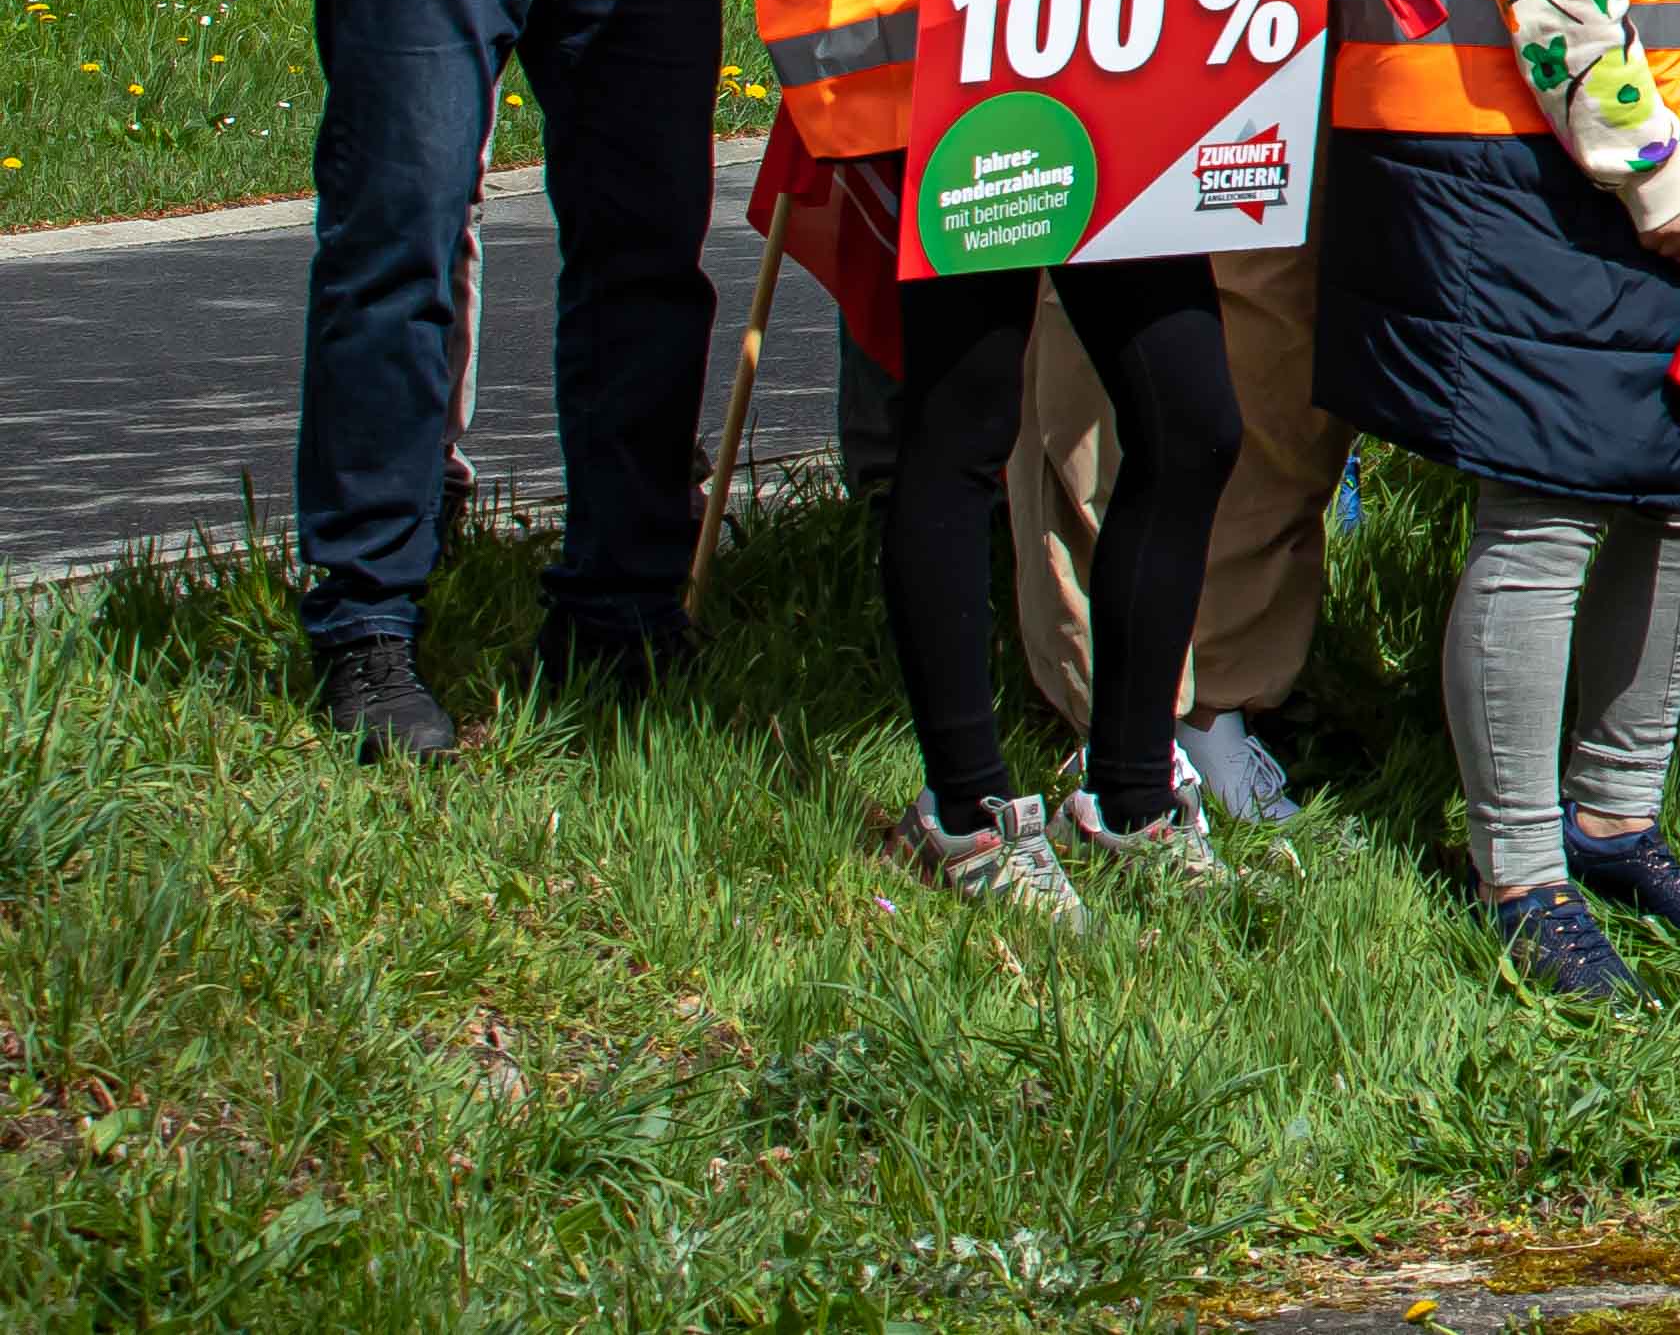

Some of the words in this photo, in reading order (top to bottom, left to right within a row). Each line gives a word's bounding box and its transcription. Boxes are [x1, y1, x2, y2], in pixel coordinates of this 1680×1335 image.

[973, 149, 1039, 179] Jahres-
[1199, 143, 1283, 167] ZUKUNFT
[939, 165, 1074, 207] sonderzahlung
[1201, 166, 1286, 190] SICHERN.
[944, 209, 970, 231] mit
[974, 191, 1070, 225] betrieblicher
[964, 219, 1050, 251] Wahloption
